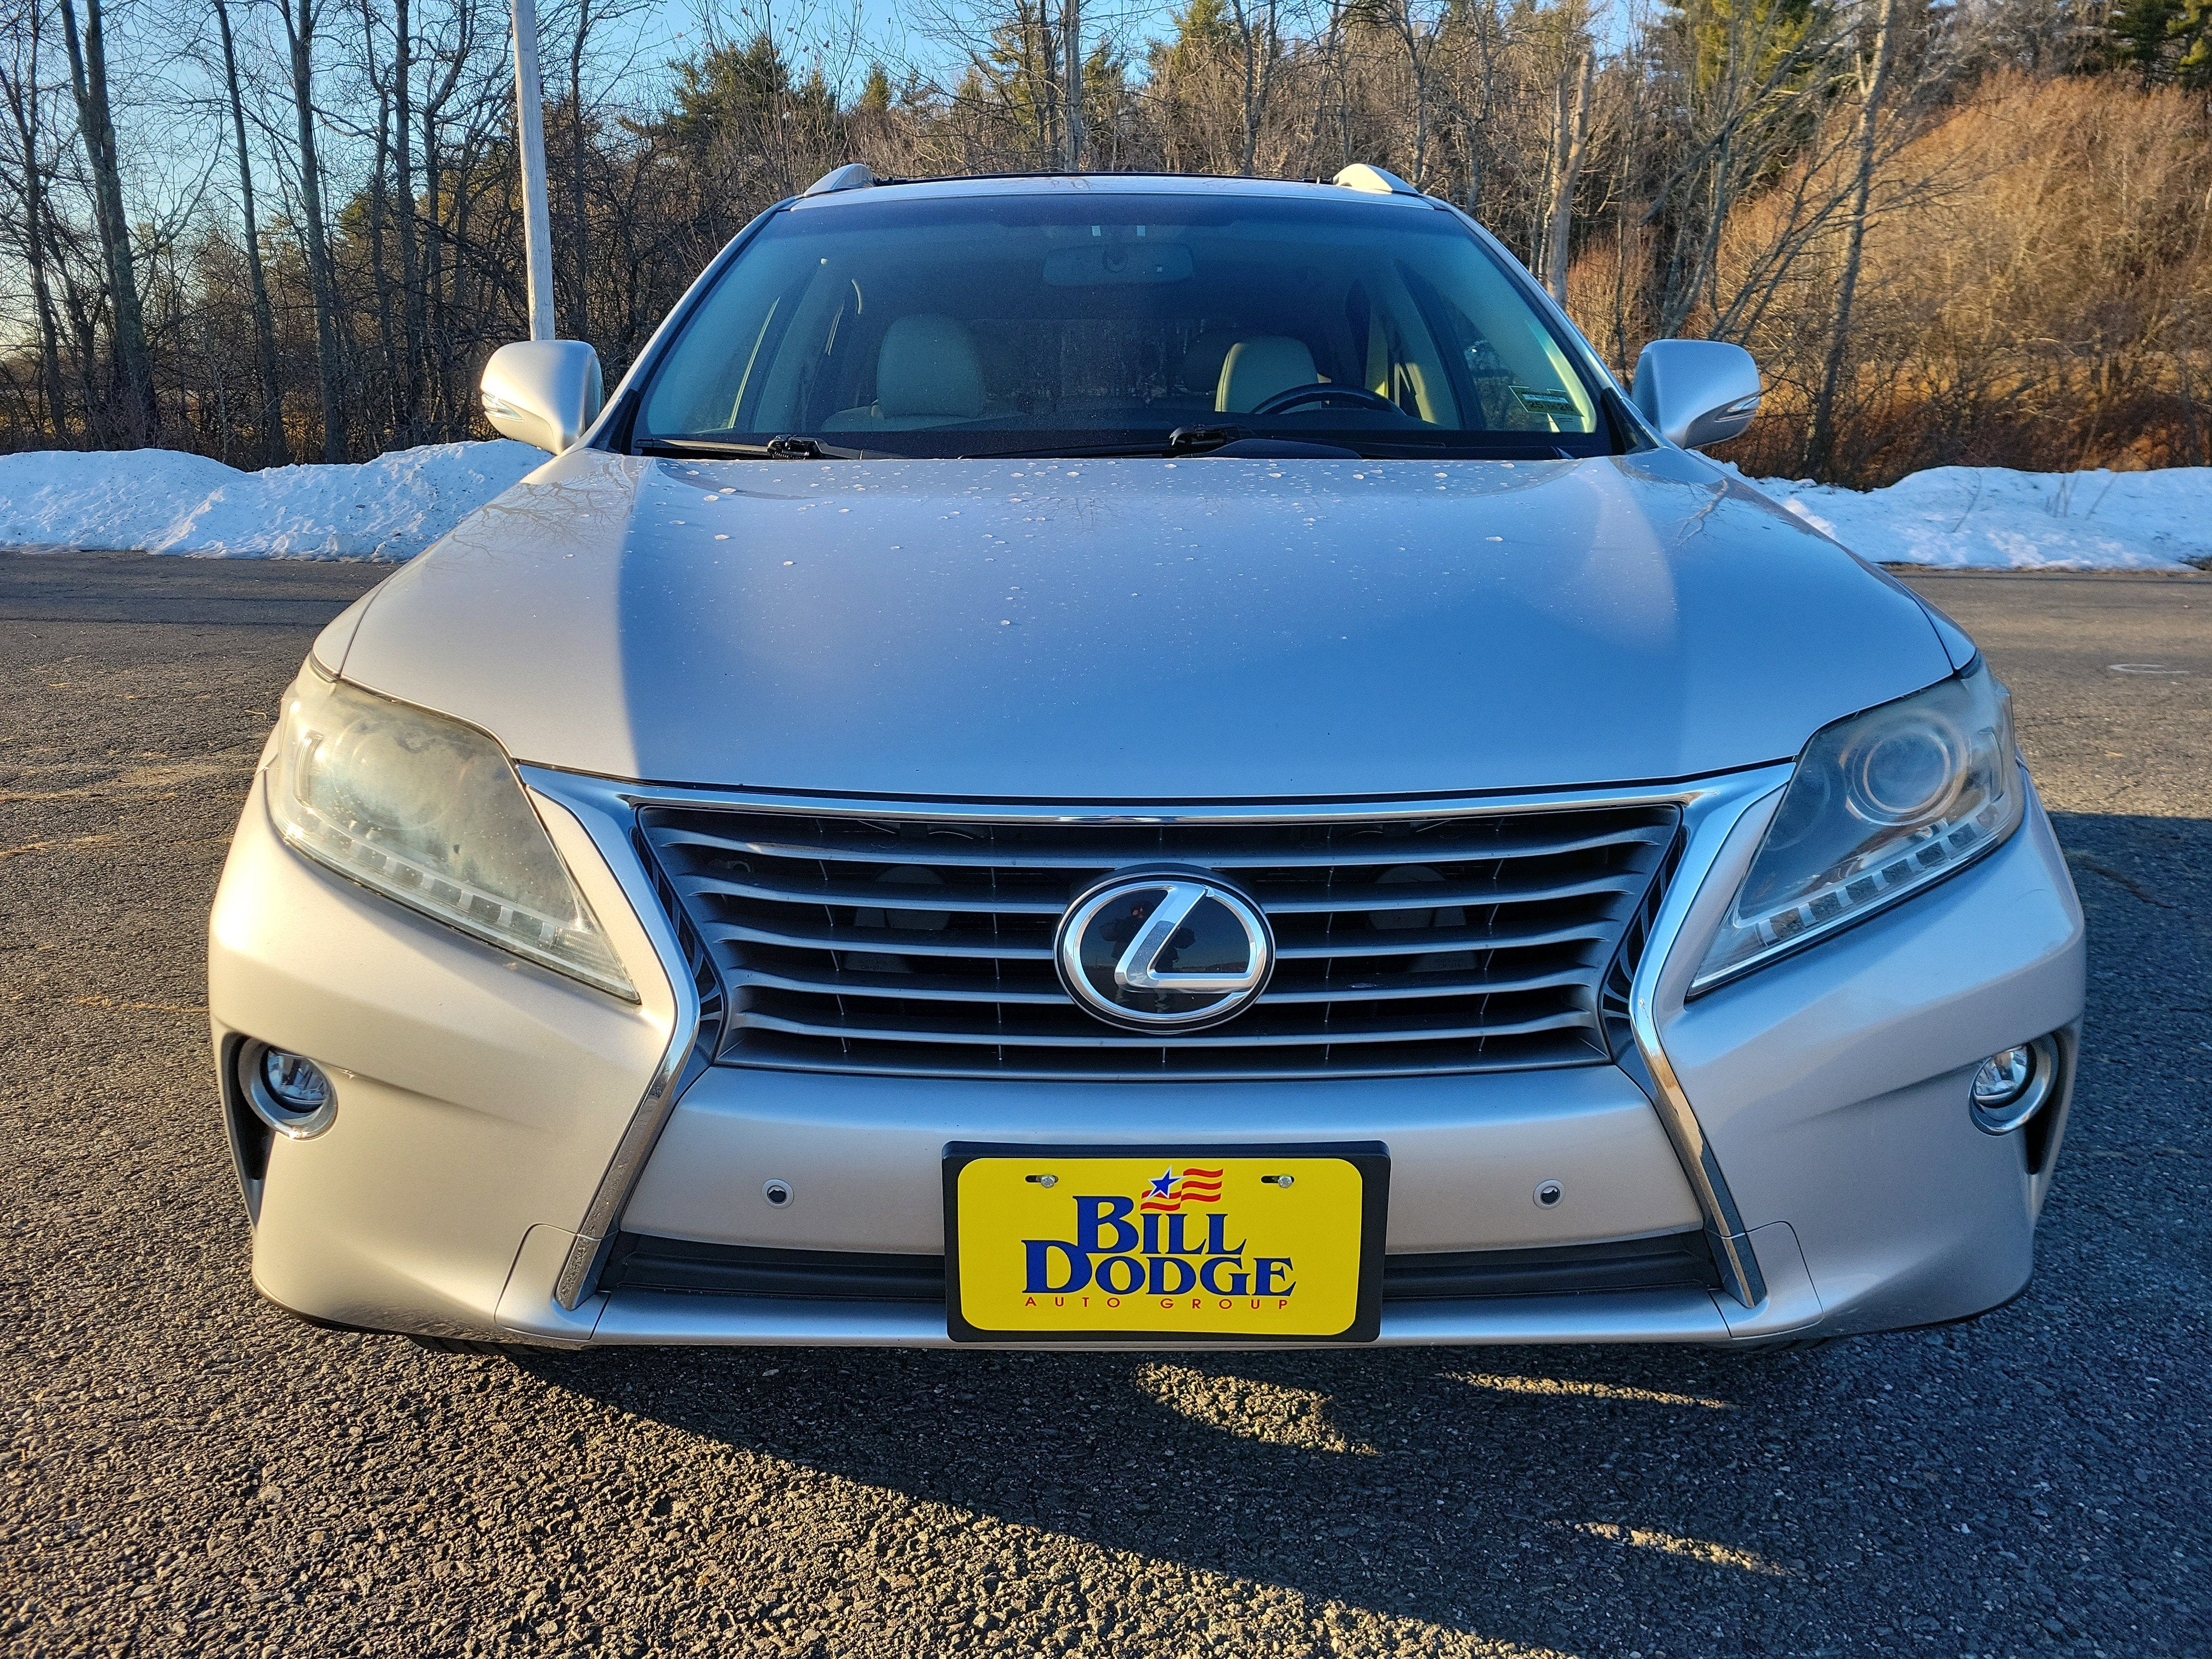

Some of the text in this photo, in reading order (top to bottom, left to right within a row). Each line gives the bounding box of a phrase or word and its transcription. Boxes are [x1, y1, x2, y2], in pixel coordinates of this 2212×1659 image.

[1073, 1195, 1247, 1255] BILL
[1021, 1239, 1297, 1296] DODGE
[1024, 1296, 1289, 1310] AUTO GROUP
